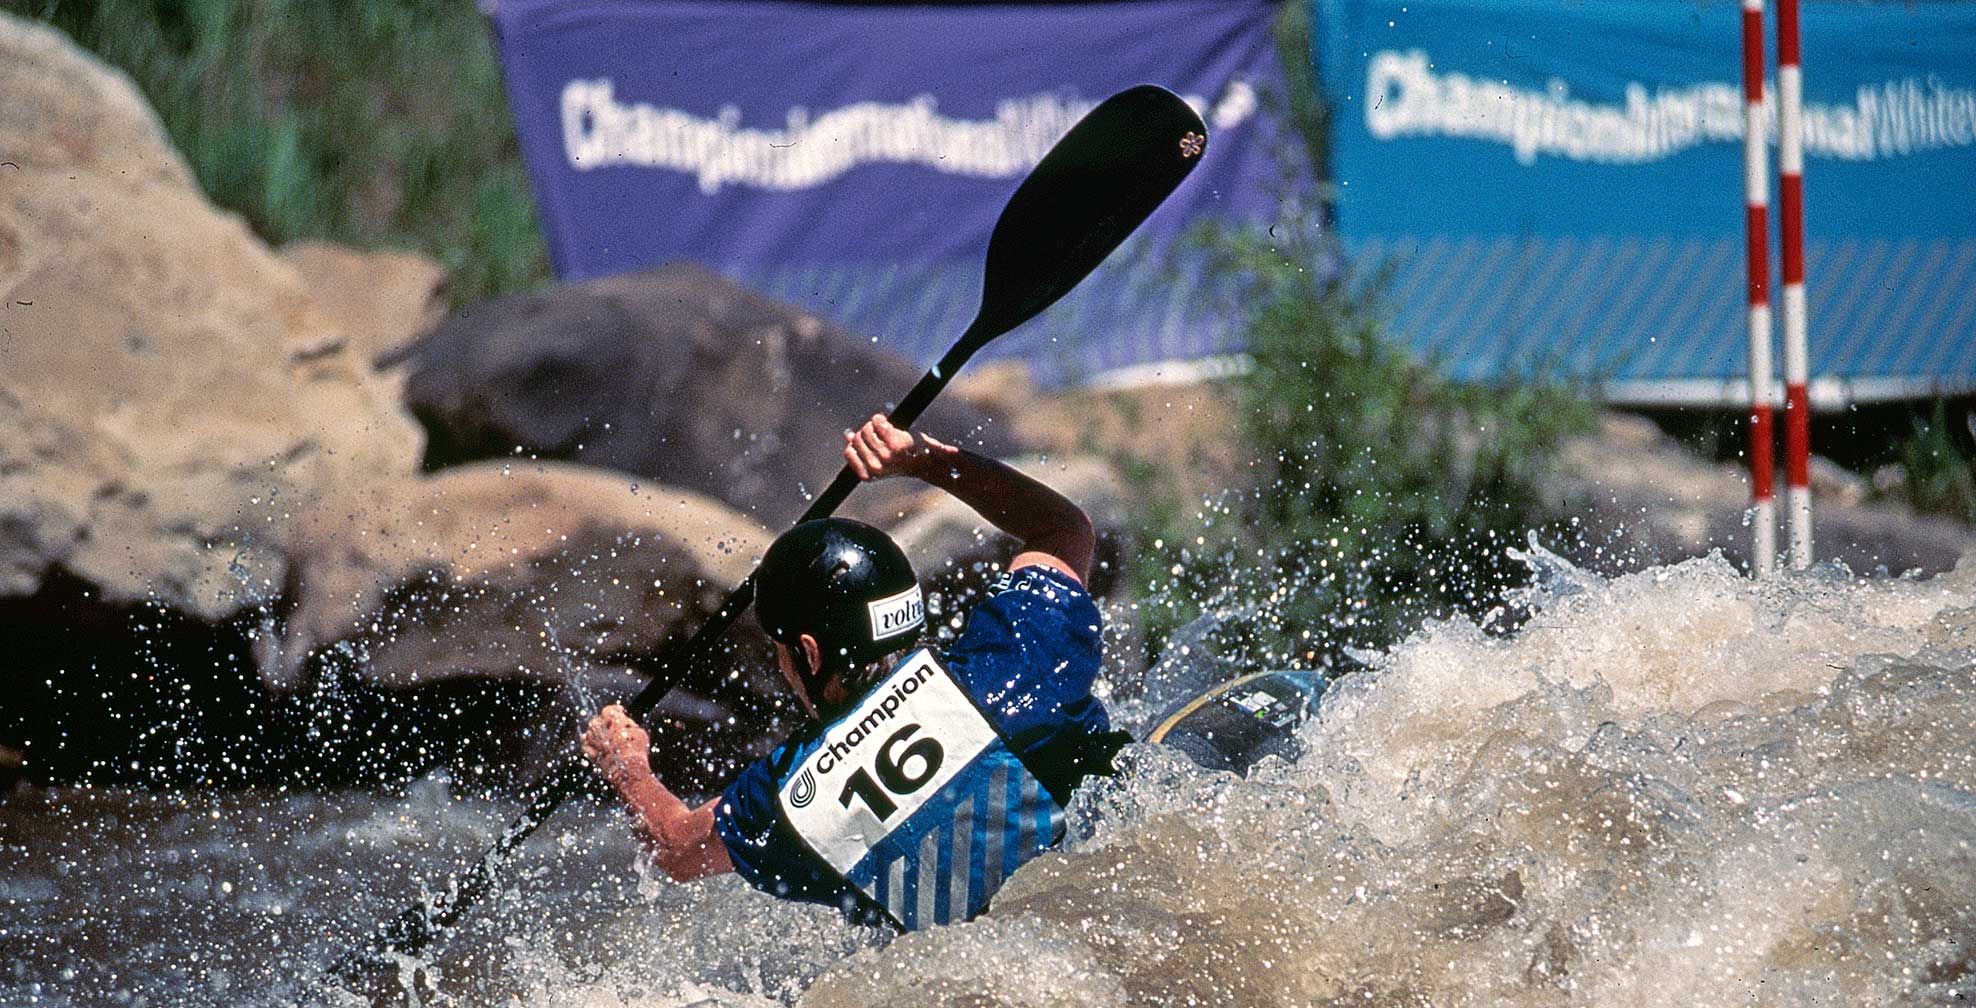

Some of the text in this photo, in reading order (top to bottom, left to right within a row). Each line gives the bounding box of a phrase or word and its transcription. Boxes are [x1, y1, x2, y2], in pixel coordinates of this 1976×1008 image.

[1367, 50, 1626, 165] Champion
[815, 663, 935, 775] Champion
[838, 723, 945, 824] 16
